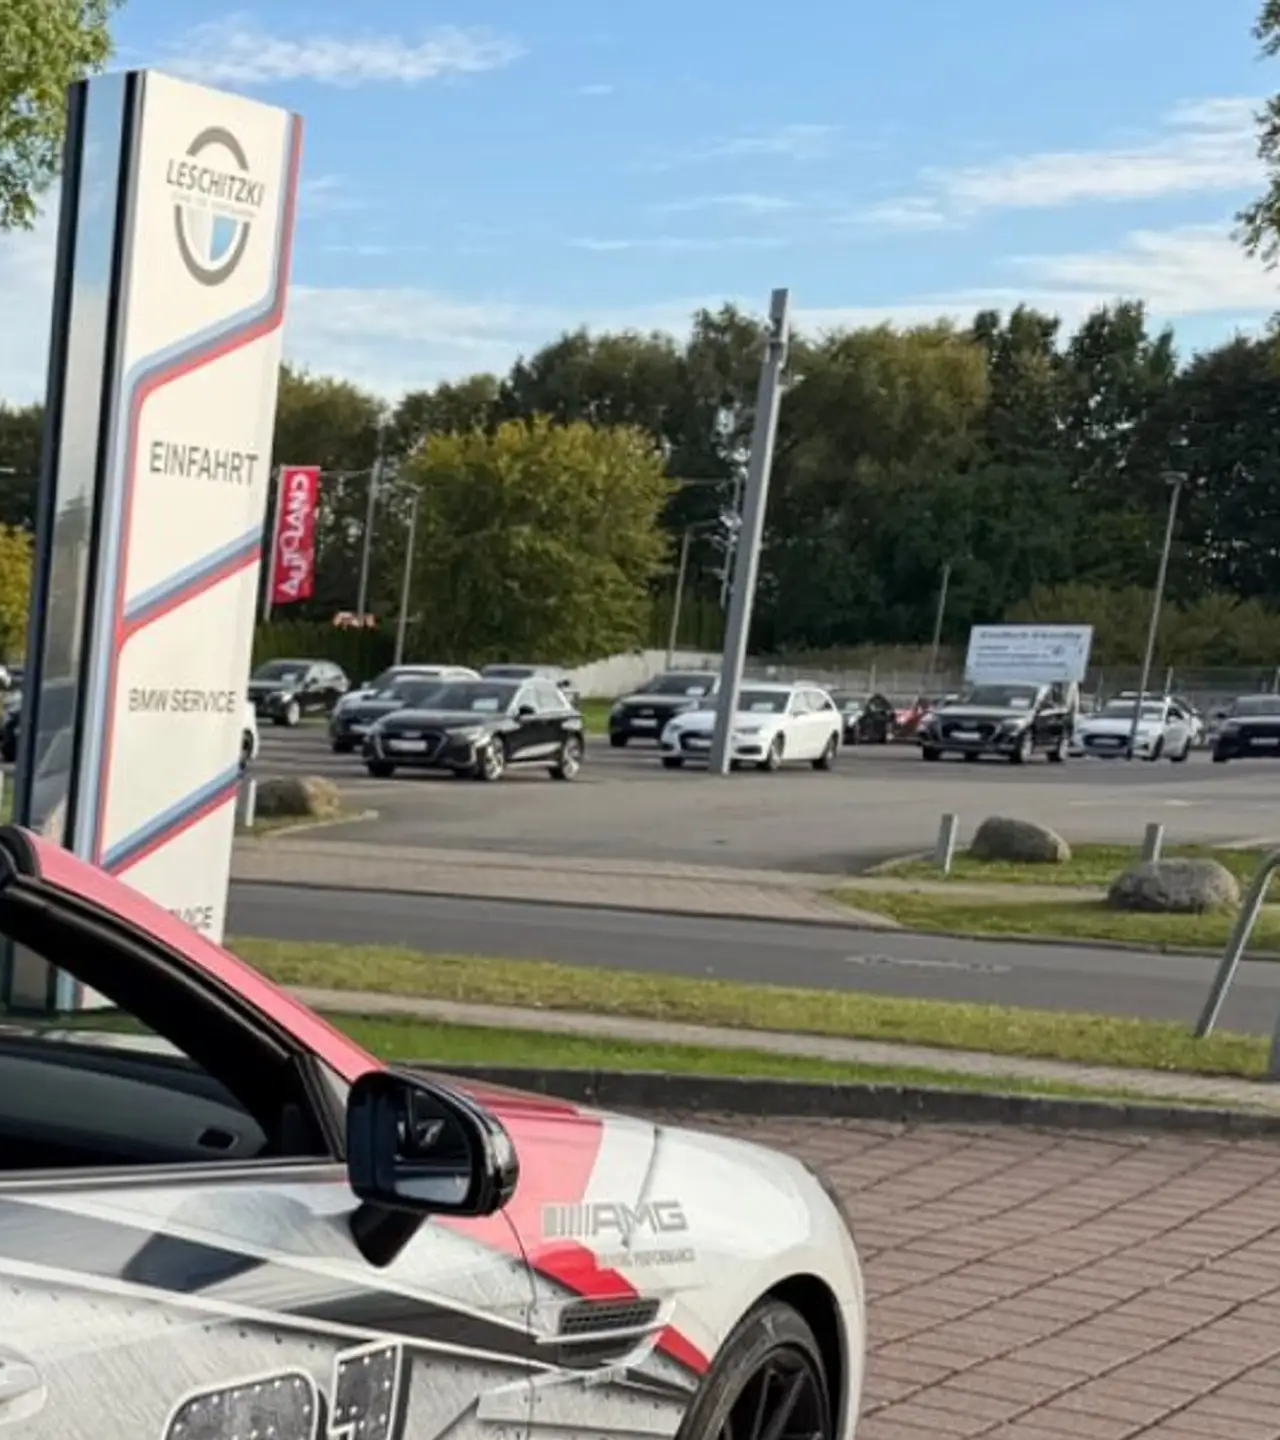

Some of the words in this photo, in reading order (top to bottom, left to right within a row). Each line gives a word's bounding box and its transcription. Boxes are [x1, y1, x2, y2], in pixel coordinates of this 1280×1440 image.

[166, 158, 265, 207] LESCHITZKI
[149, 441, 259, 487] EINFAHRT
[129, 688, 169, 711] BMW
[171, 689, 237, 713] SERVICE
[590, 1203, 689, 1237] AMG
